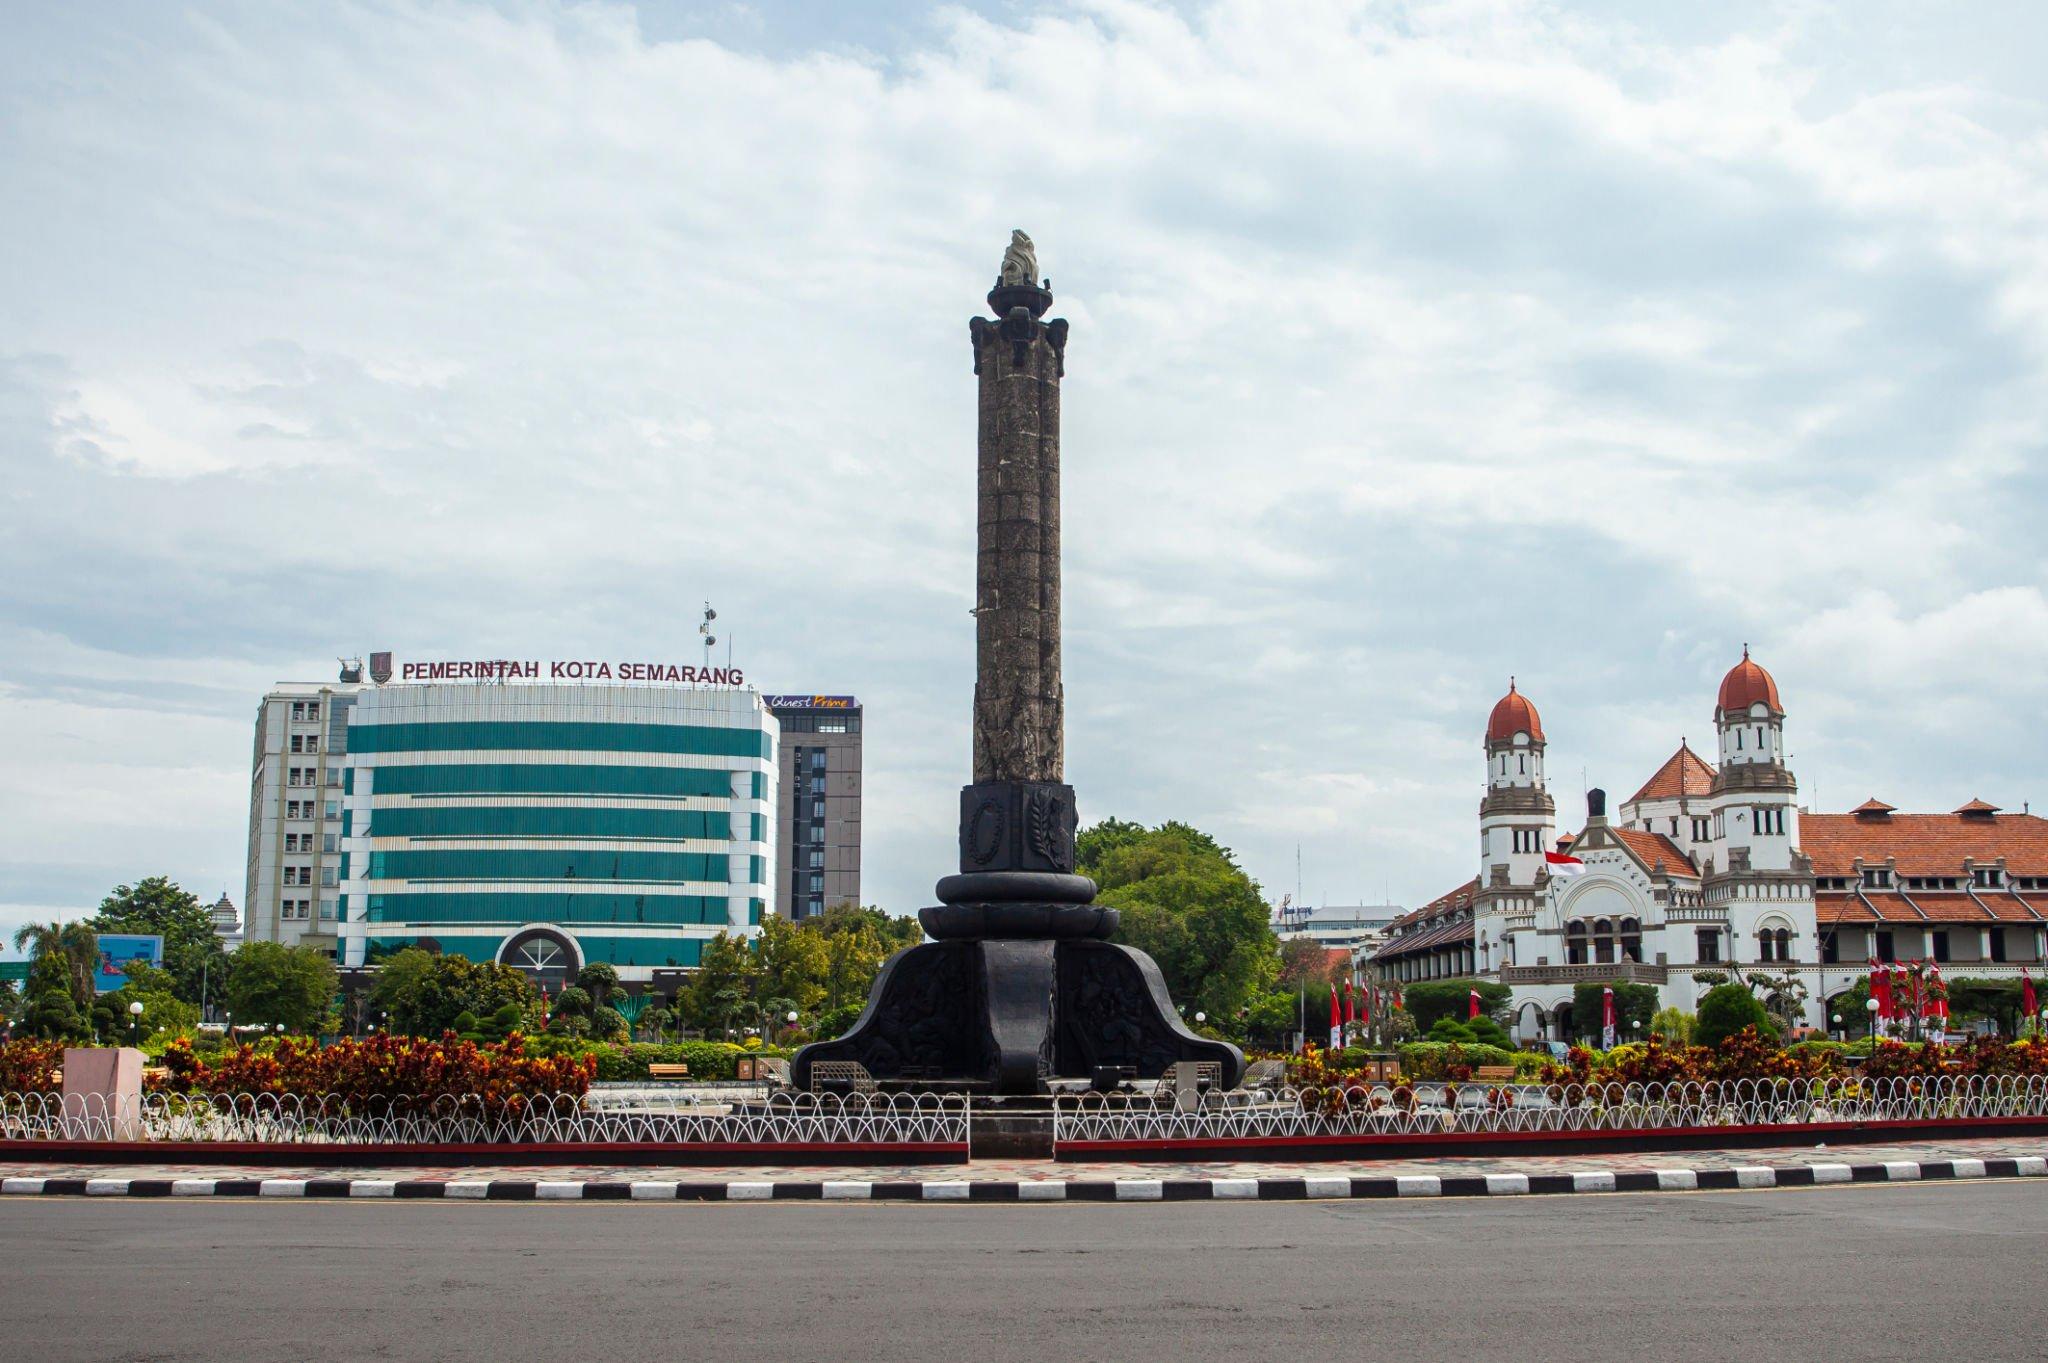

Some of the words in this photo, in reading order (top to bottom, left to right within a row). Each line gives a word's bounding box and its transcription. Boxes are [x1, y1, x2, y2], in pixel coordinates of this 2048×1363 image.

[403, 661, 539, 679] PEMERINTAH
[551, 661, 612, 679] KOTA
[618, 663, 744, 685] SEMARANG
[771, 695, 812, 707] Quest
[813, 695, 848, 708] Prime
